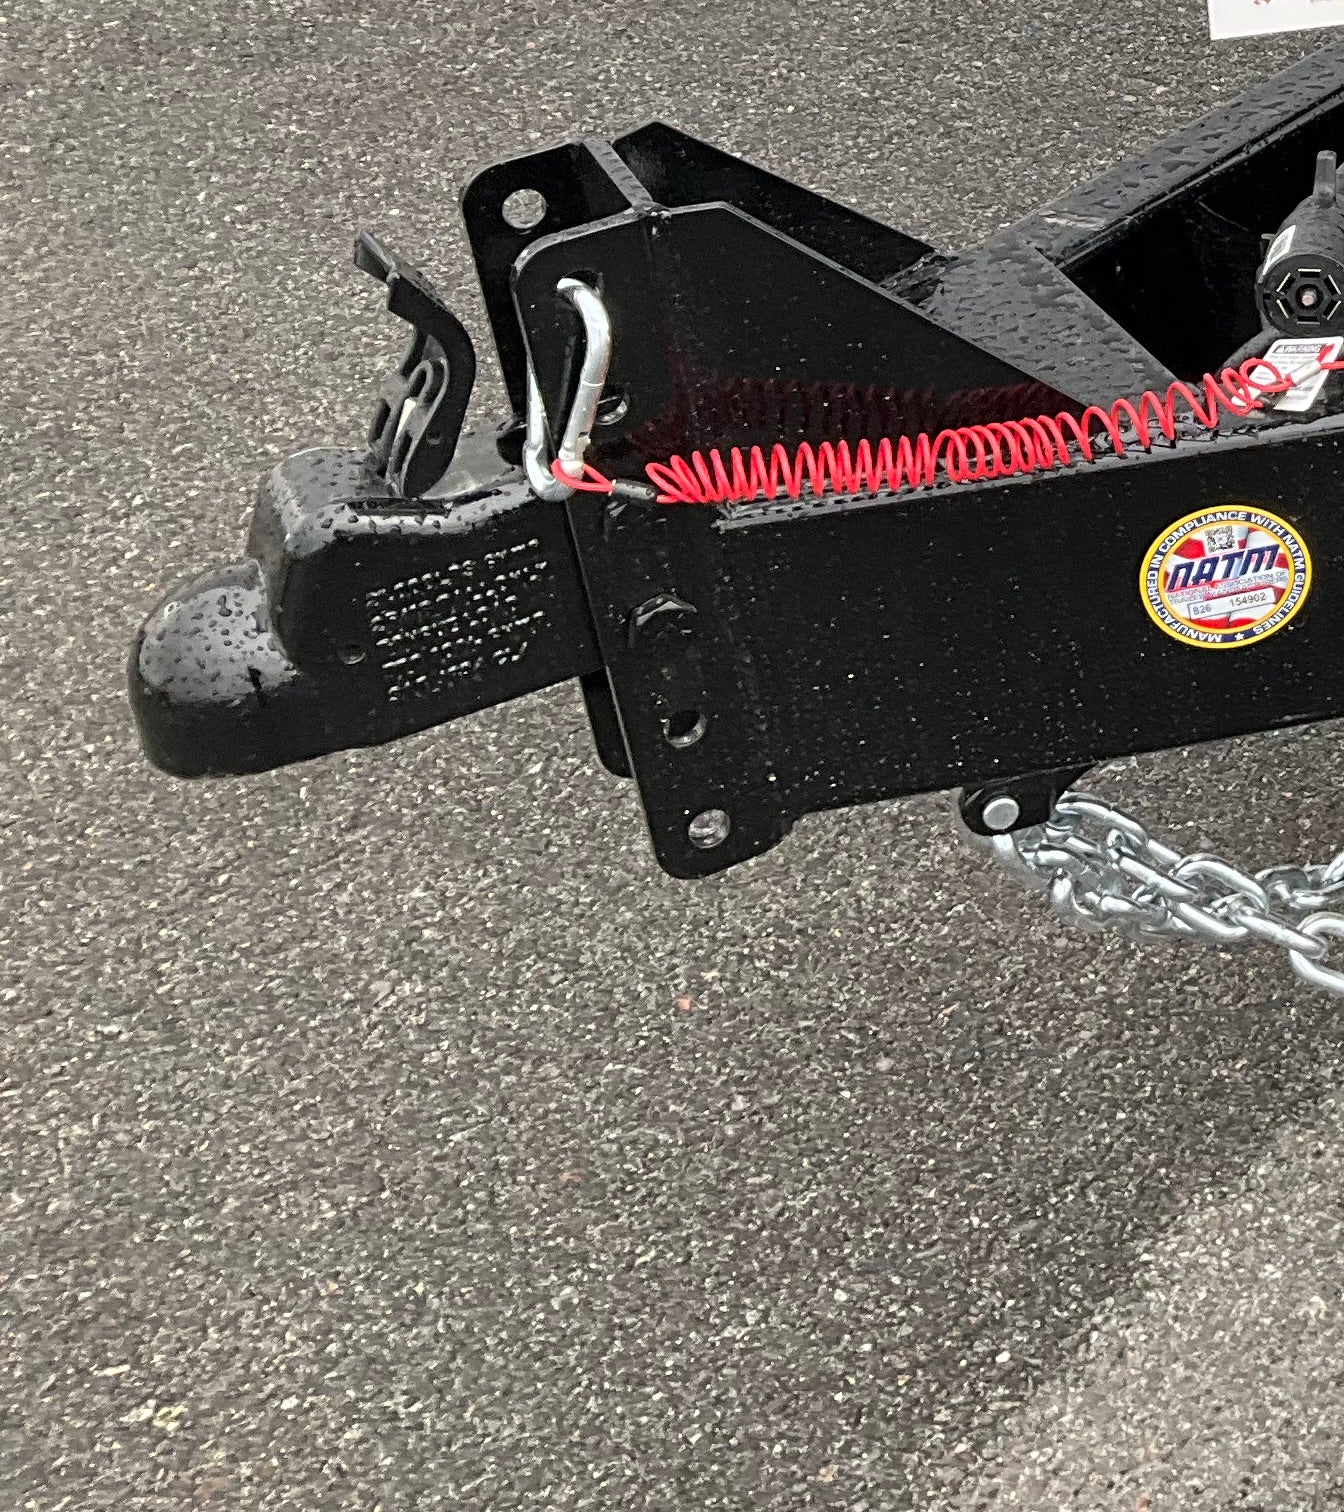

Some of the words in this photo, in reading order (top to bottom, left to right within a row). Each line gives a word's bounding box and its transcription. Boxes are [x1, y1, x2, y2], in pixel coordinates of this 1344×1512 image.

[1158, 511, 1247, 553] COMPLIANCE
[1249, 513, 1285, 536] WITH
[1152, 557, 1164, 570] IN
[1283, 534, 1306, 572] NATM
[1147, 571, 1223, 644] MANUFACTURED
[1252, 572, 1305, 635] GUIDELINES
